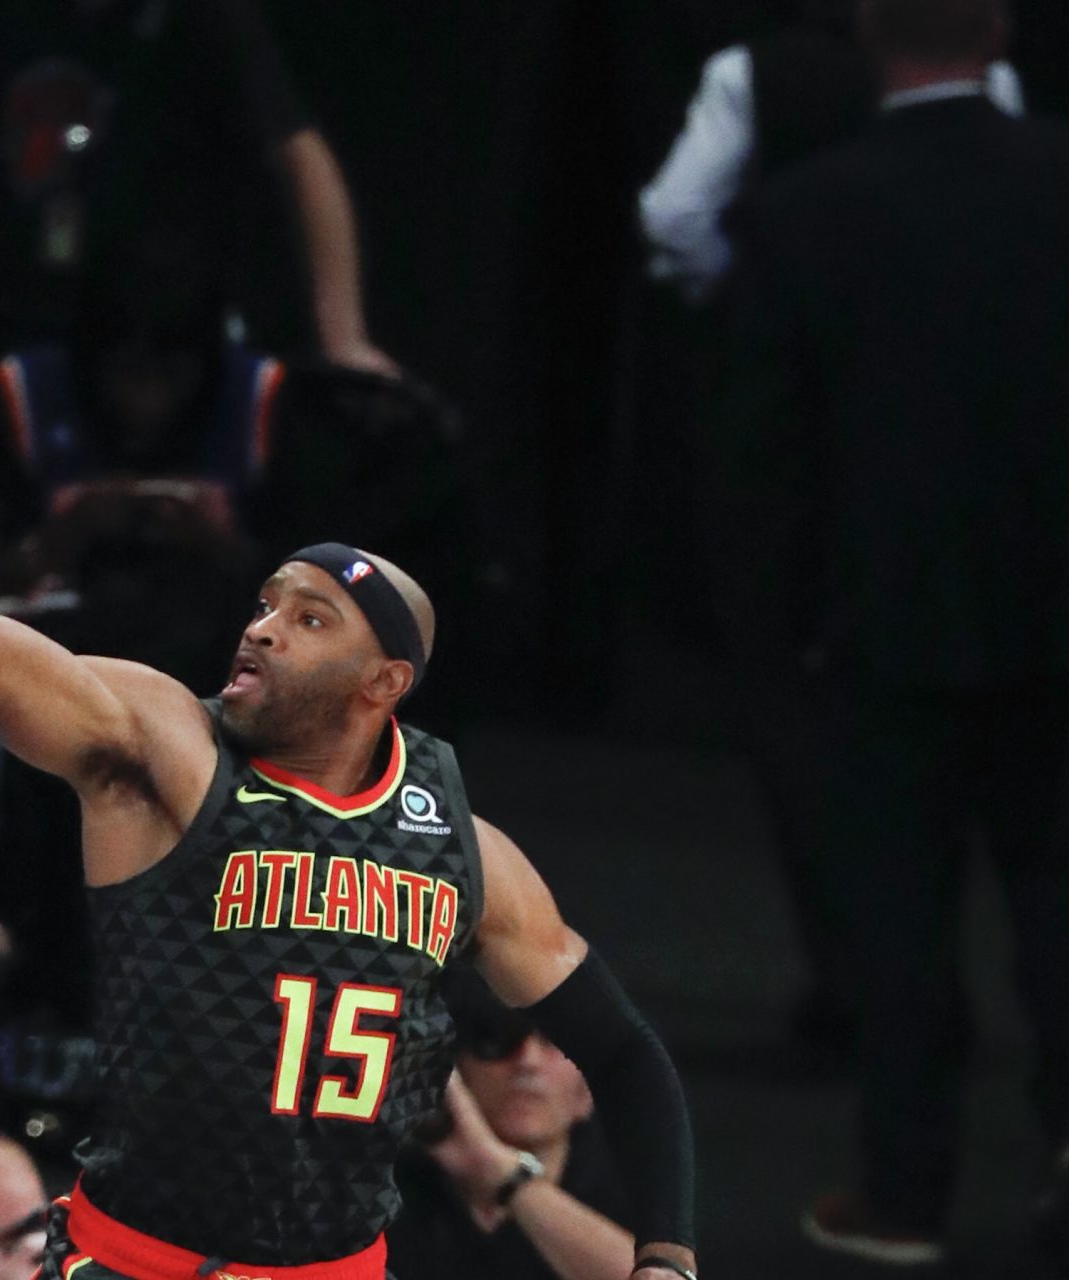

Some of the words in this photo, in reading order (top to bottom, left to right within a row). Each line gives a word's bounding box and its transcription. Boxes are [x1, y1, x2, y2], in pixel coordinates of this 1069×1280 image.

[397, 819, 451, 835] sharecare
[213, 851, 458, 967] ATLANTA
[271, 973, 403, 1123] 15
